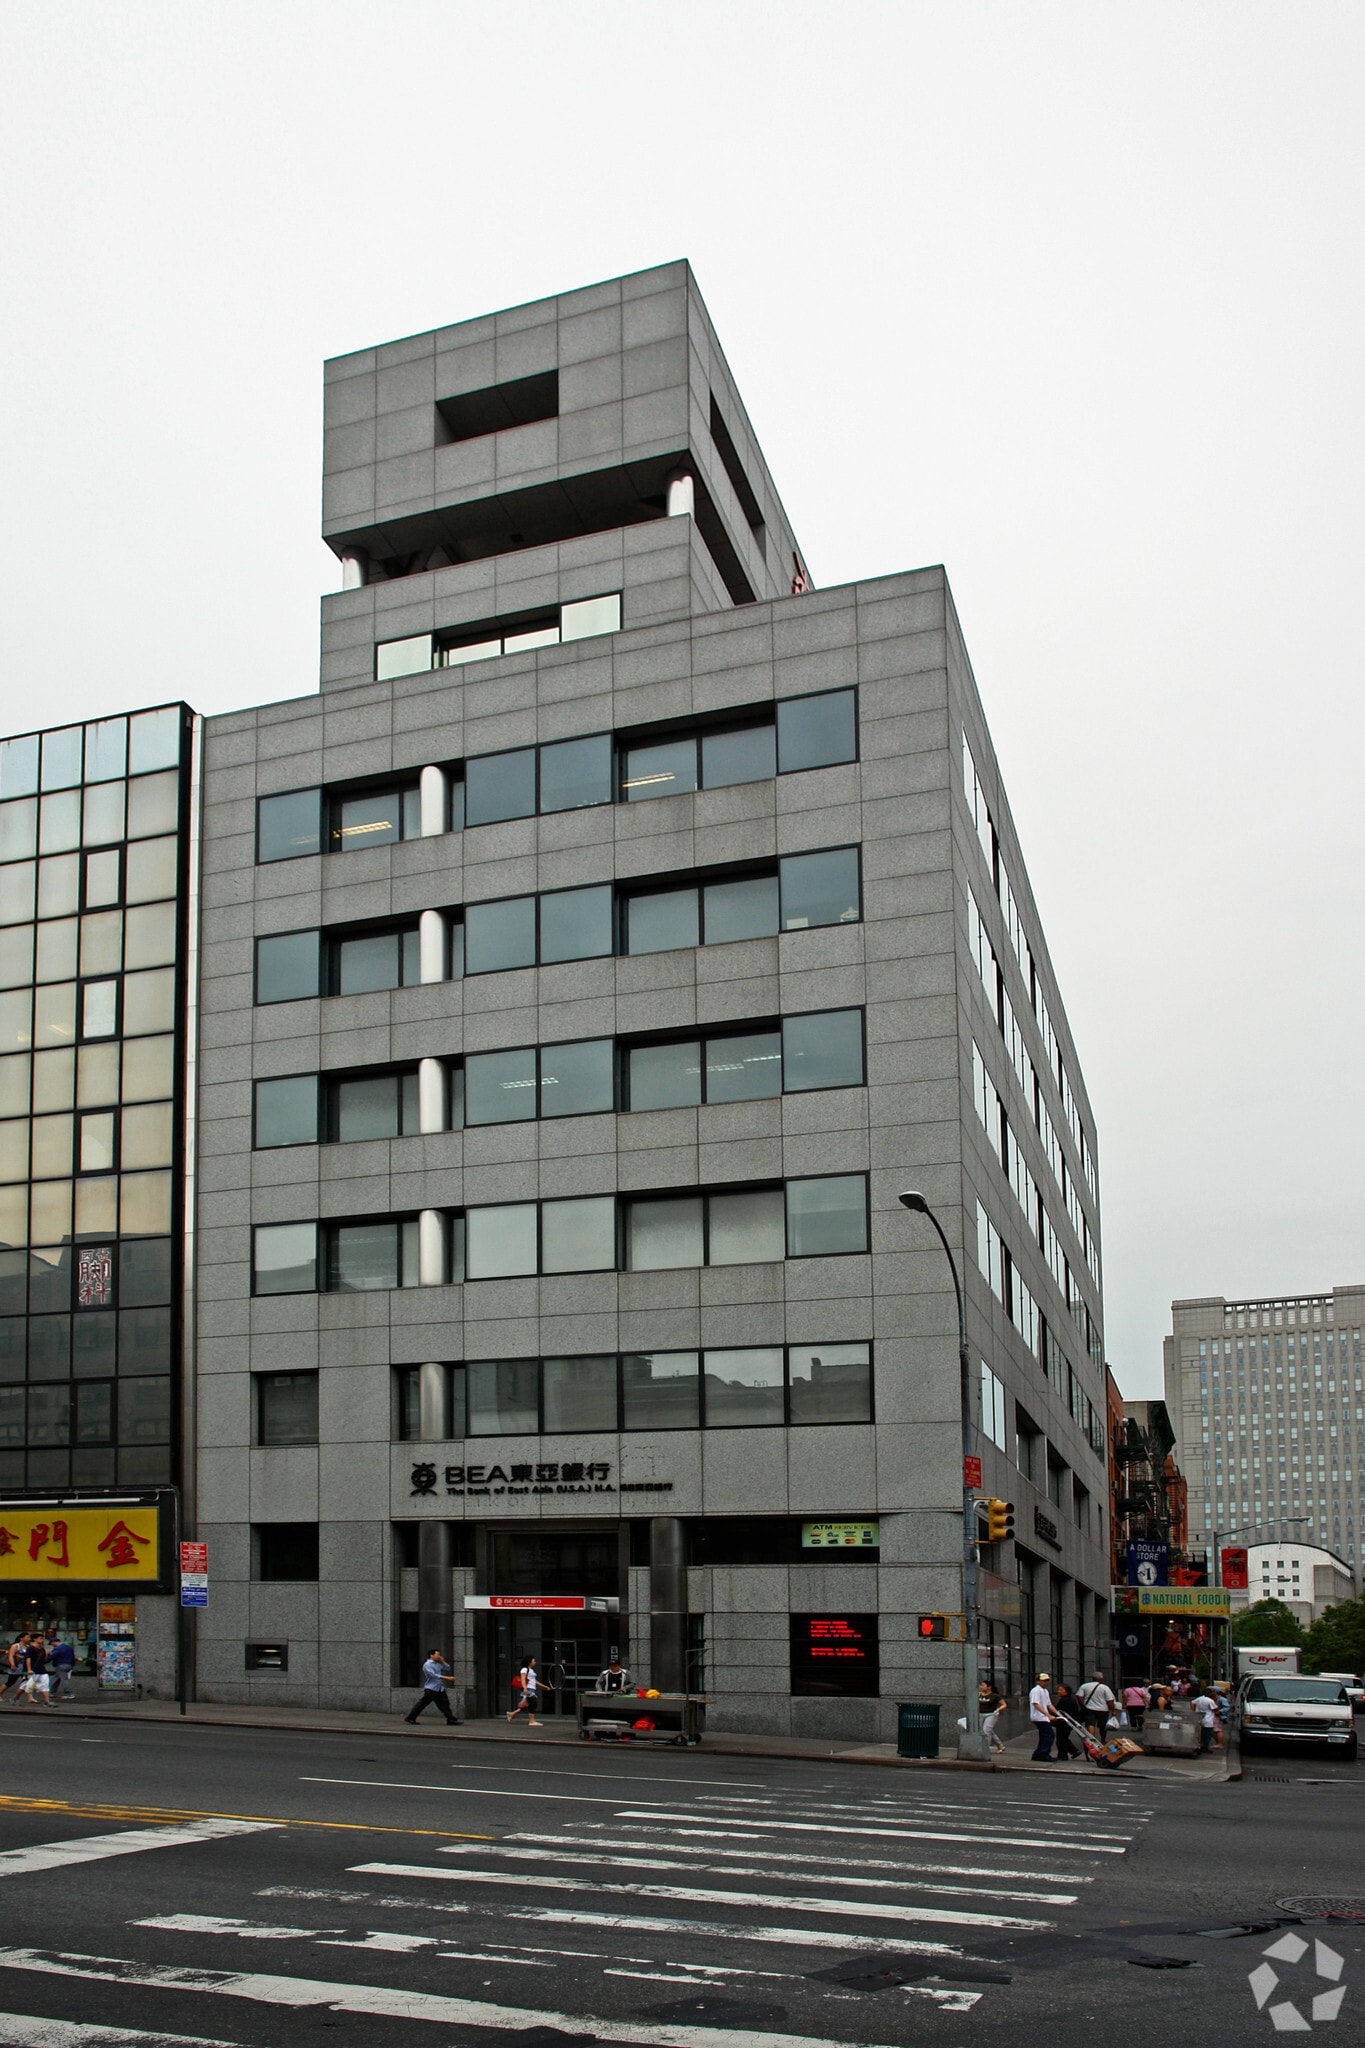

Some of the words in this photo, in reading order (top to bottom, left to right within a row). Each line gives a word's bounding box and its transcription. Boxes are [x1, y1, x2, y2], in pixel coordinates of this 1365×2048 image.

[467, 1486, 491, 1496] Bank
[494, 1486, 505, 1495] of
[508, 1486, 529, 1495] East
[532, 1485, 553, 1494] Asia
[1130, 1543, 1135, 1551] A
[1137, 1543, 1167, 1553] DOLLAR
[1136, 1552, 1159, 1561] STORE
[1152, 1593, 1193, 1606] NATURAL
[1197, 1593, 1221, 1606] FOOD
[1257, 1655, 1288, 1664] Ryder
